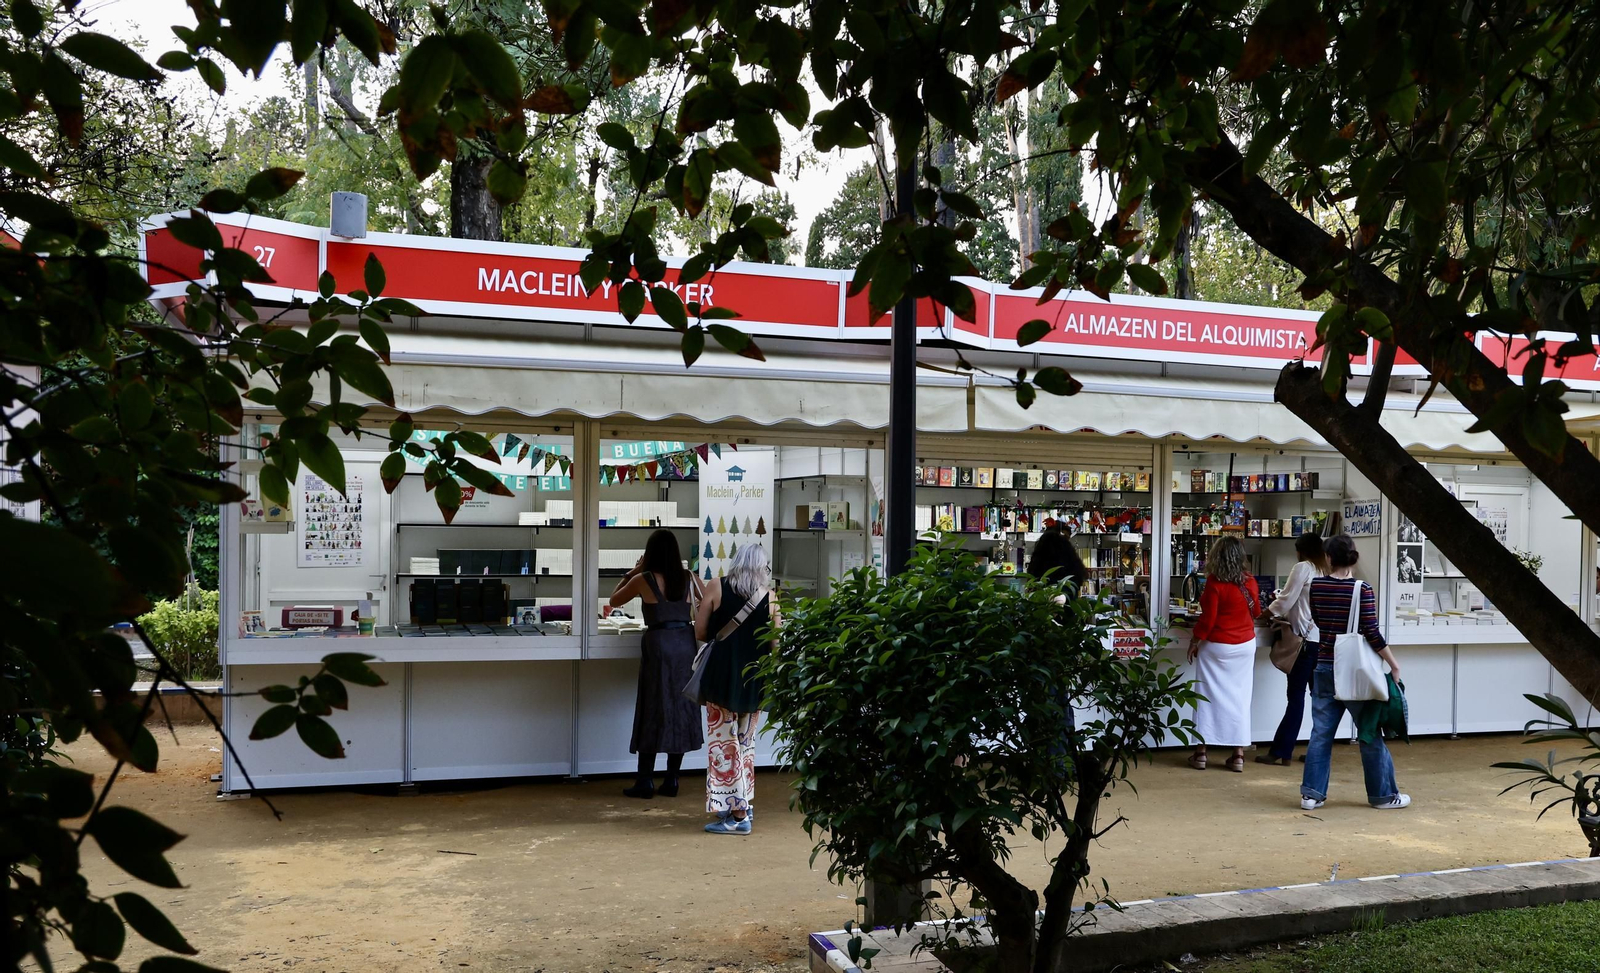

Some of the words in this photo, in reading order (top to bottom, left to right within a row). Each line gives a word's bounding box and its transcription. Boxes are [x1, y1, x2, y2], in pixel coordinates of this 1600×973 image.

[253, 245, 276, 268] 27
[478, 267, 589, 298] MACLEIN
[601, 279, 613, 299] Y
[1064, 312, 1157, 339] ALMAZEN
[1162, 320, 1197, 342] DEL
[1200, 324, 1308, 350] ALQUIMISTA
[614, 441, 683, 458] BUENA
[541, 476, 567, 490] EL
[706, 485, 734, 498] Maclein
[740, 485, 765, 498] Parker
[1344, 506, 1352, 519] EL
